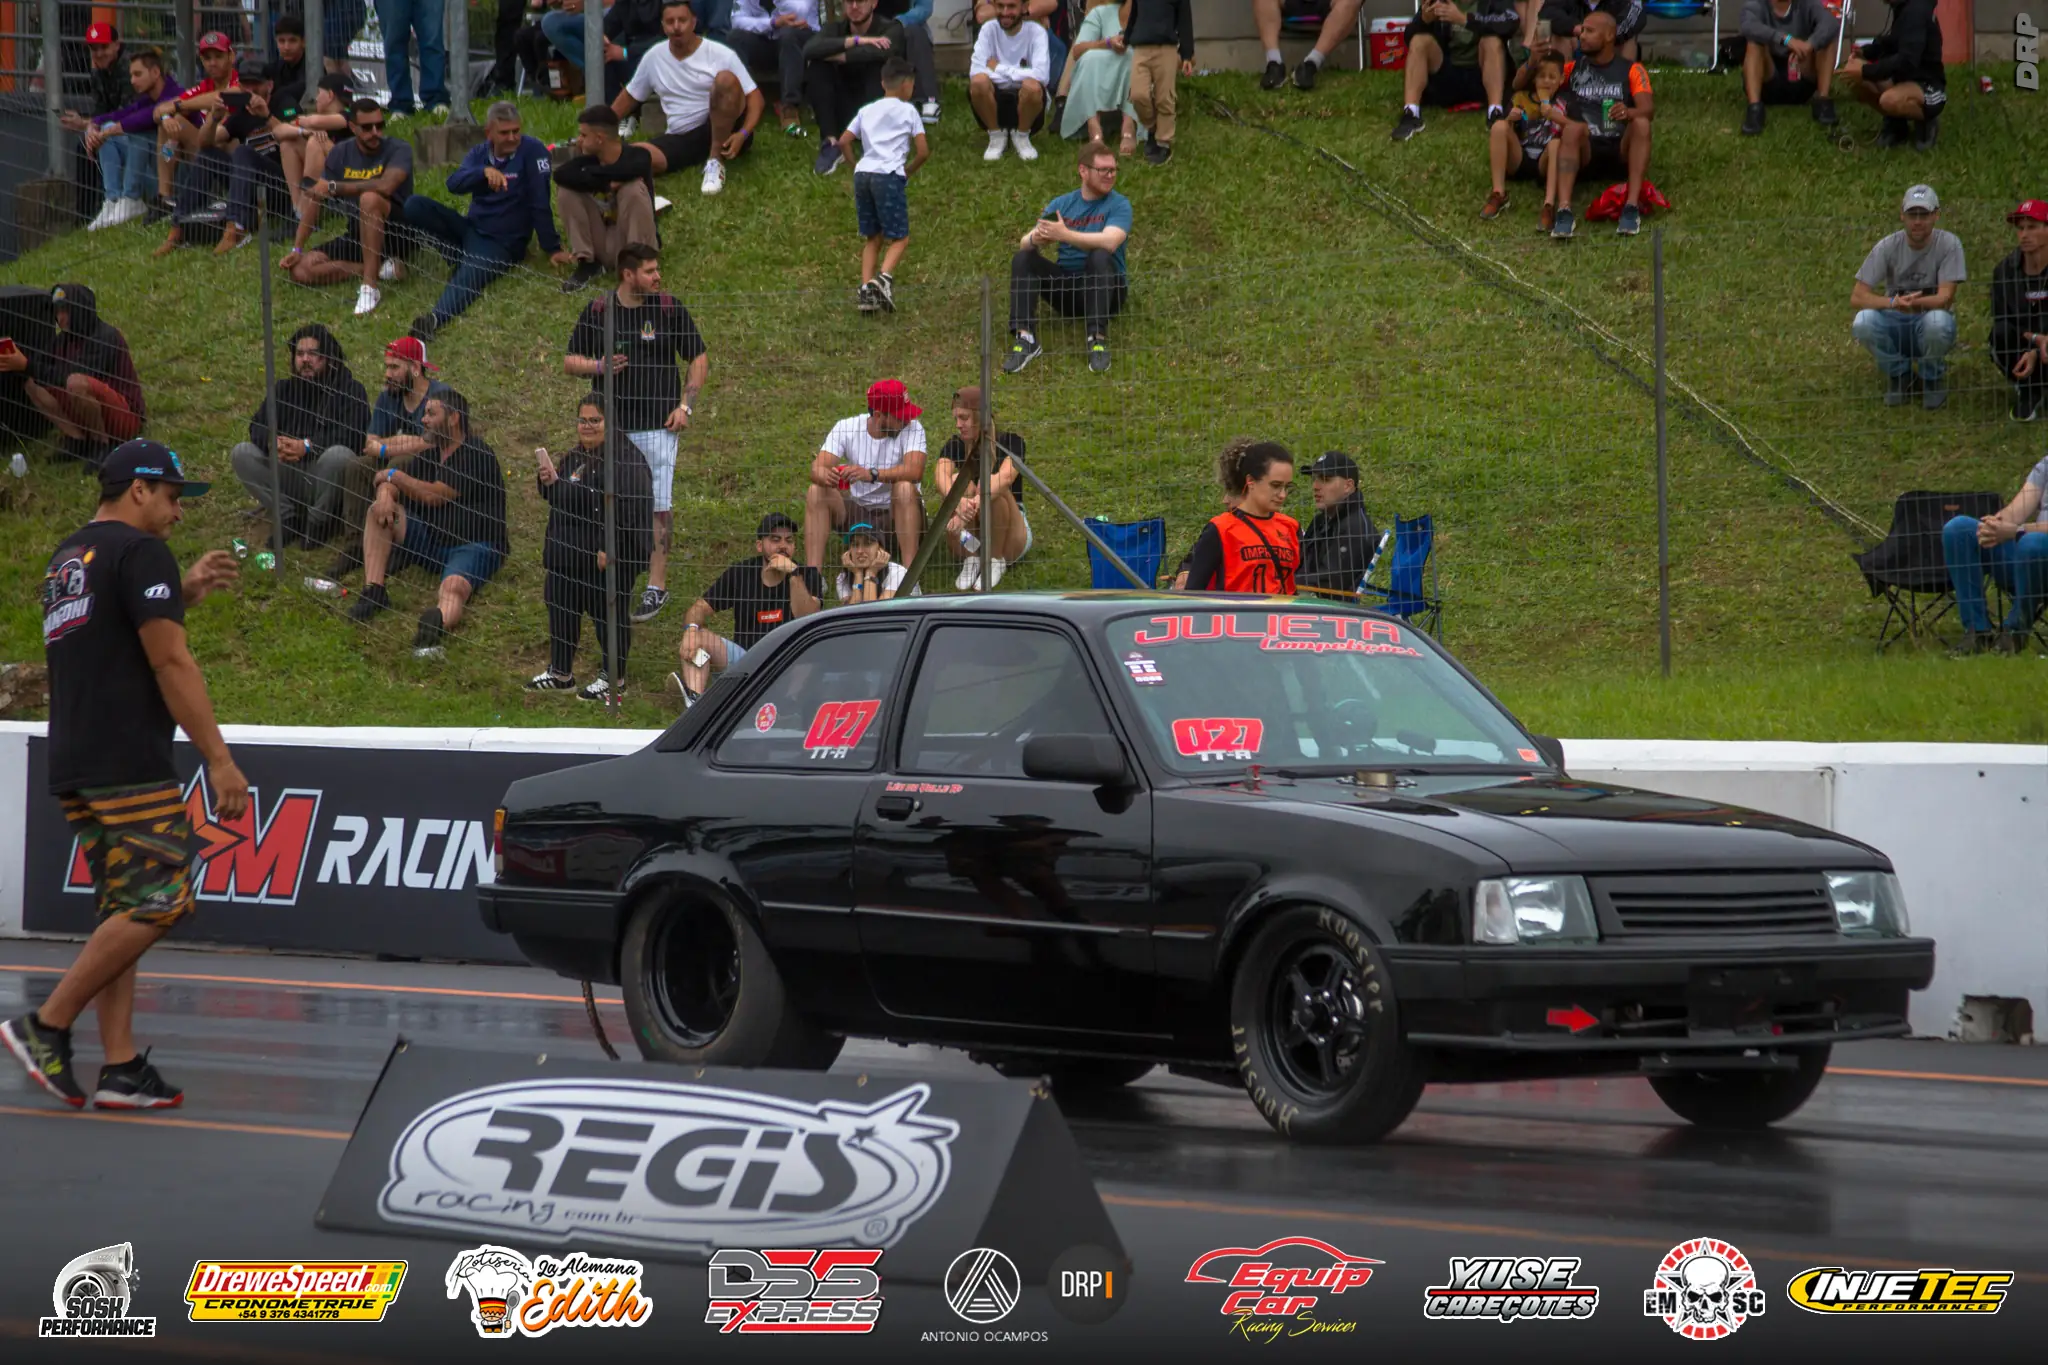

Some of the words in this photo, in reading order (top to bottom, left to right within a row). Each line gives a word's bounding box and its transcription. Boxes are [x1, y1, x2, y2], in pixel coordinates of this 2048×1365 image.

[1134, 614, 1400, 645] JULIETA
[1260, 637, 1425, 657] Competições
[803, 700, 881, 749] 027
[1172, 718, 1263, 755] 027
[415, 1185, 555, 1224] racing
